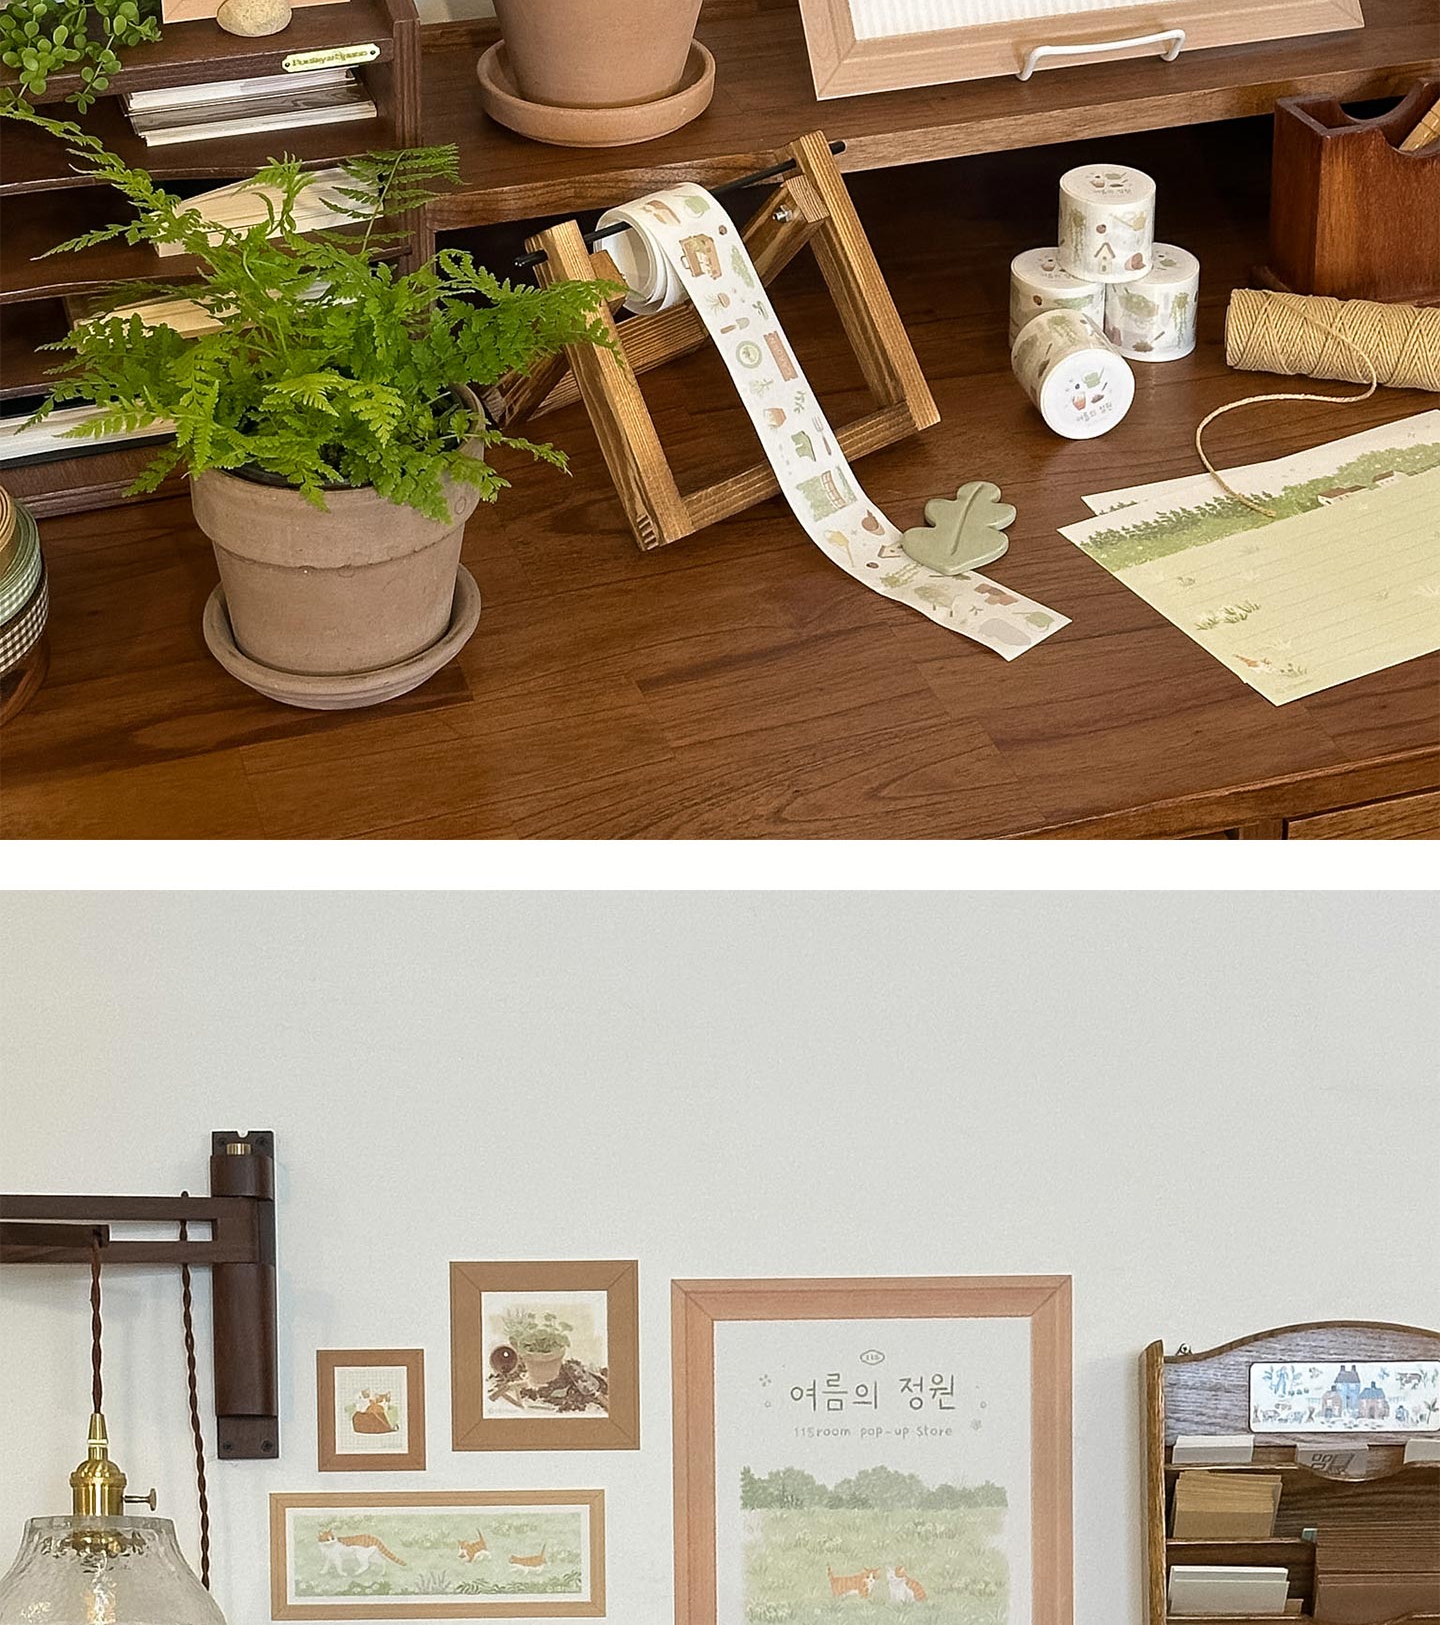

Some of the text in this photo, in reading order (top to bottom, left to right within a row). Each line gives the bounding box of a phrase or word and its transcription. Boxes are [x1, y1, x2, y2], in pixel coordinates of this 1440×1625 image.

[790, 1372, 957, 1412] 여름의 정원
[860, 1427, 910, 1440] pop-up
